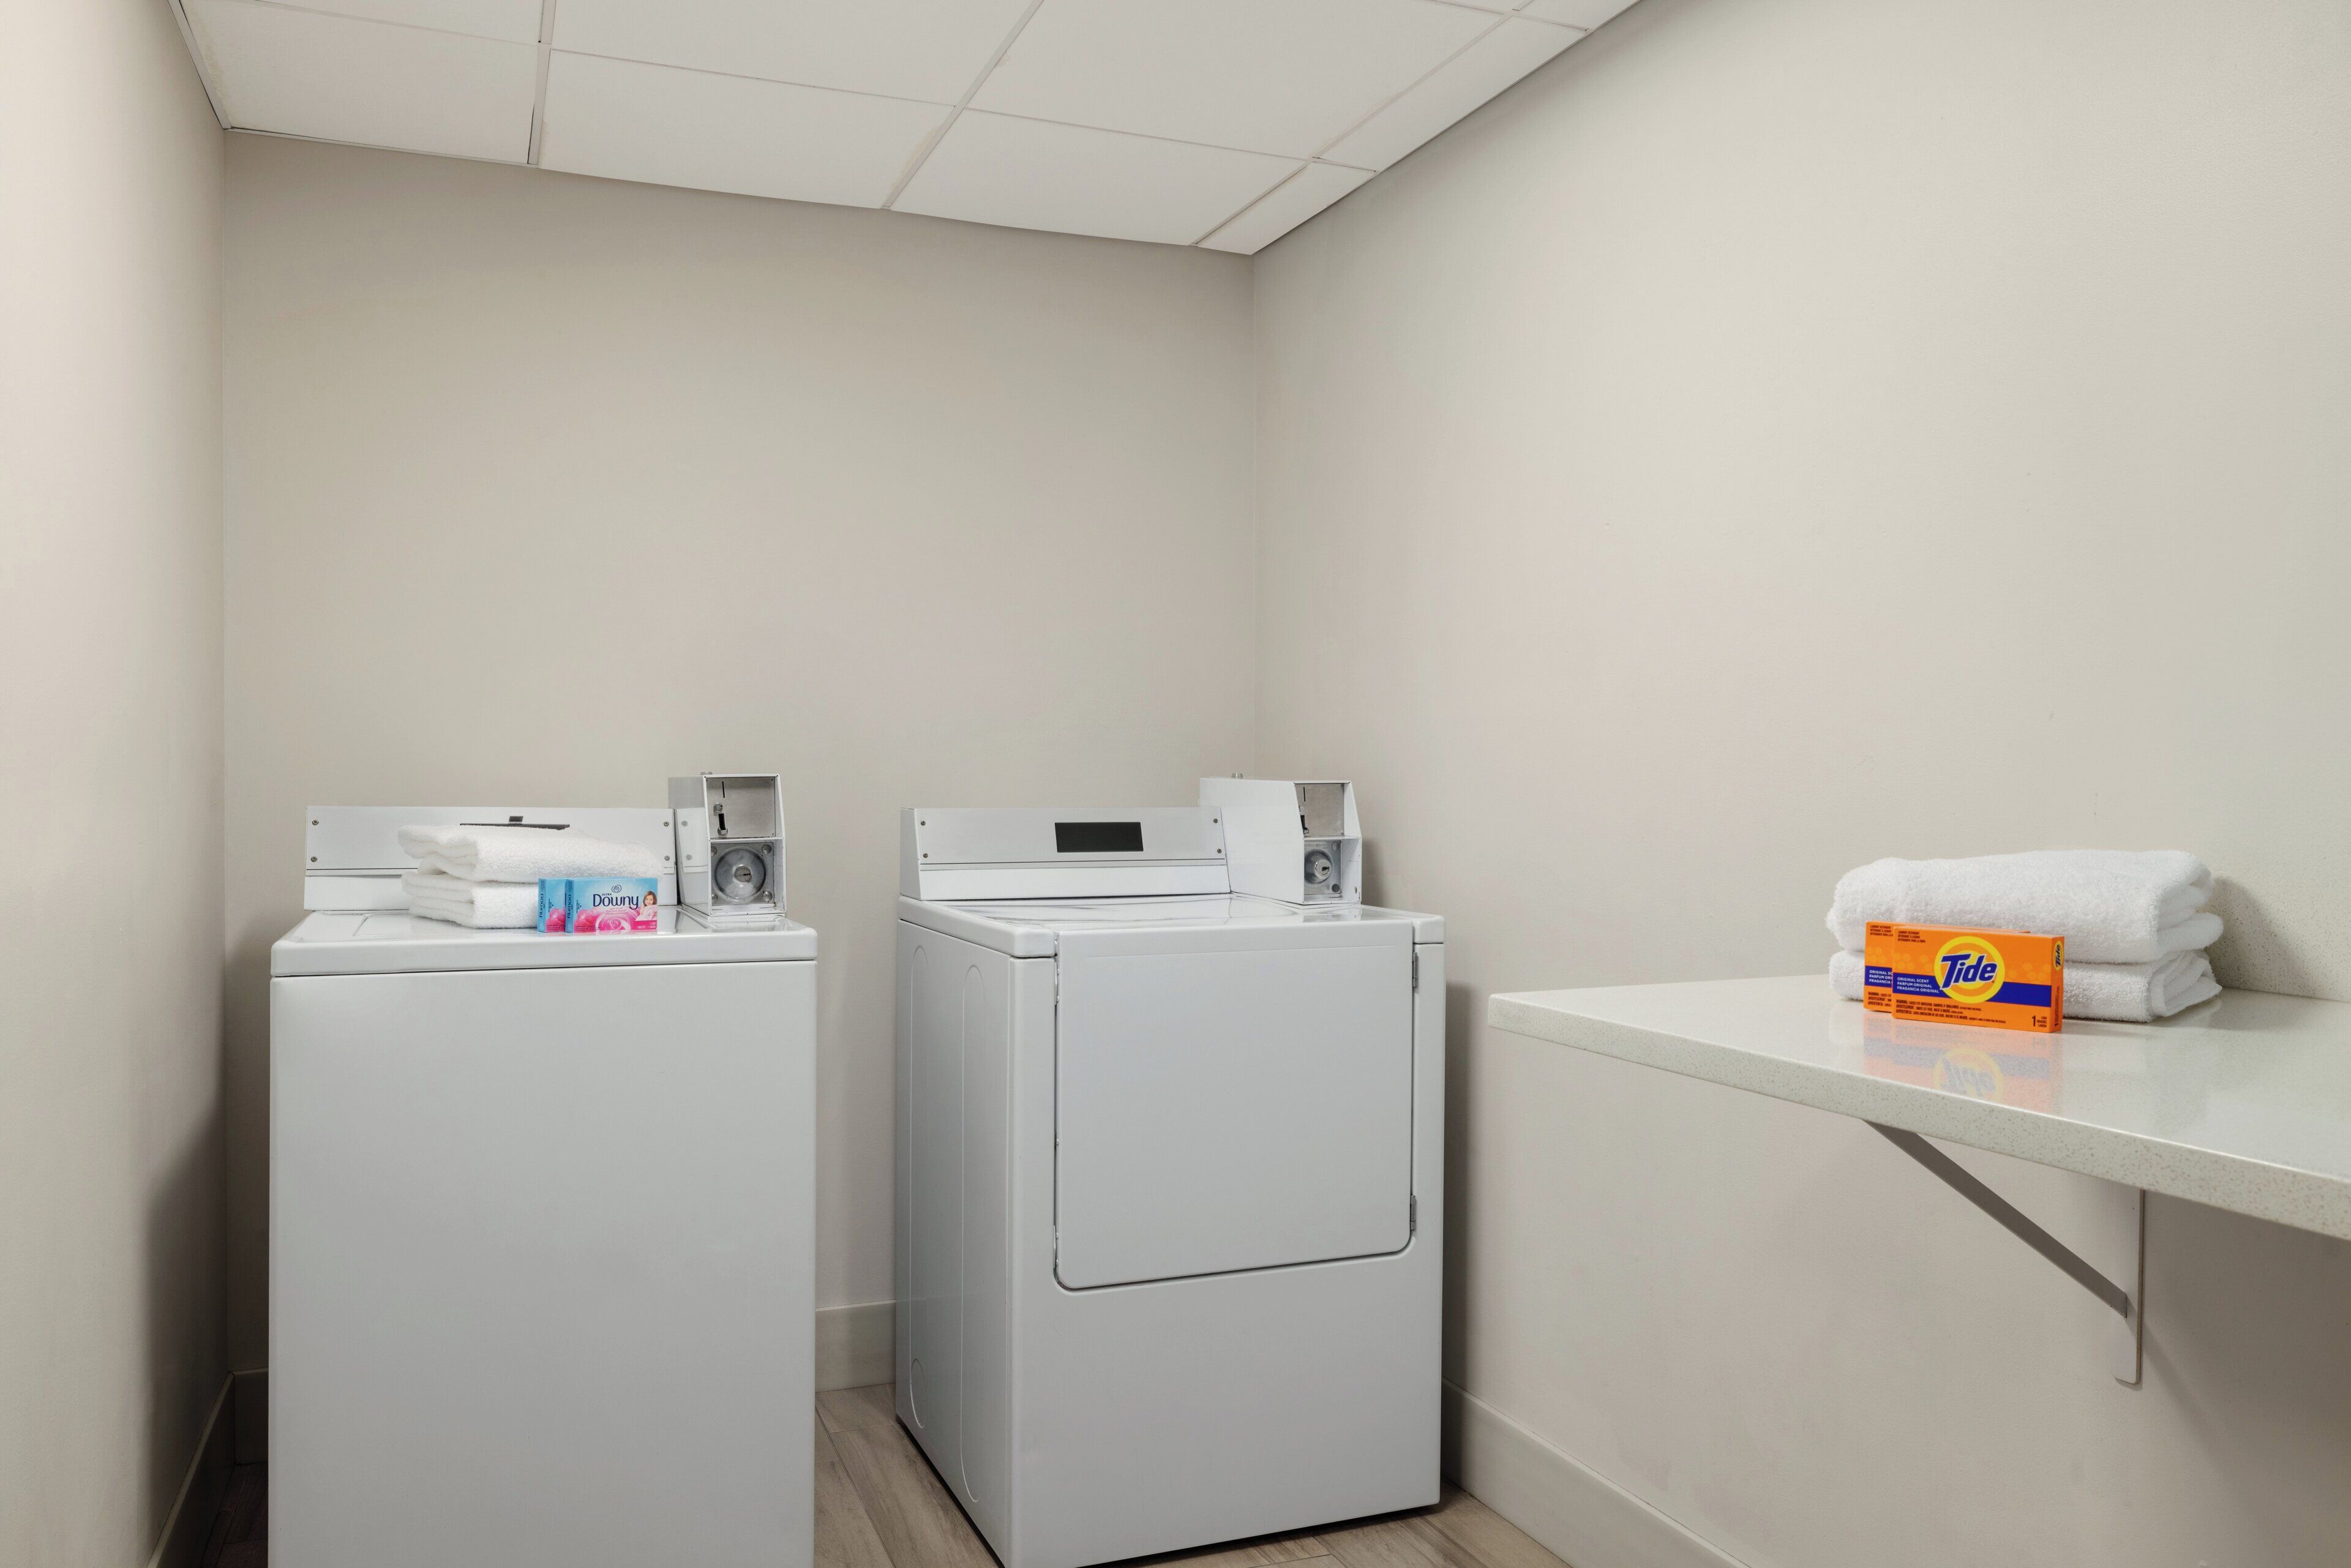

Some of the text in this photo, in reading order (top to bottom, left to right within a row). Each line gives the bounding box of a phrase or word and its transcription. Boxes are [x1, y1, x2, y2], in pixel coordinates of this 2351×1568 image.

[593, 894, 639, 910] Downy
[1940, 952, 1998, 990] Tide
[2031, 1015, 2036, 1027] 1
